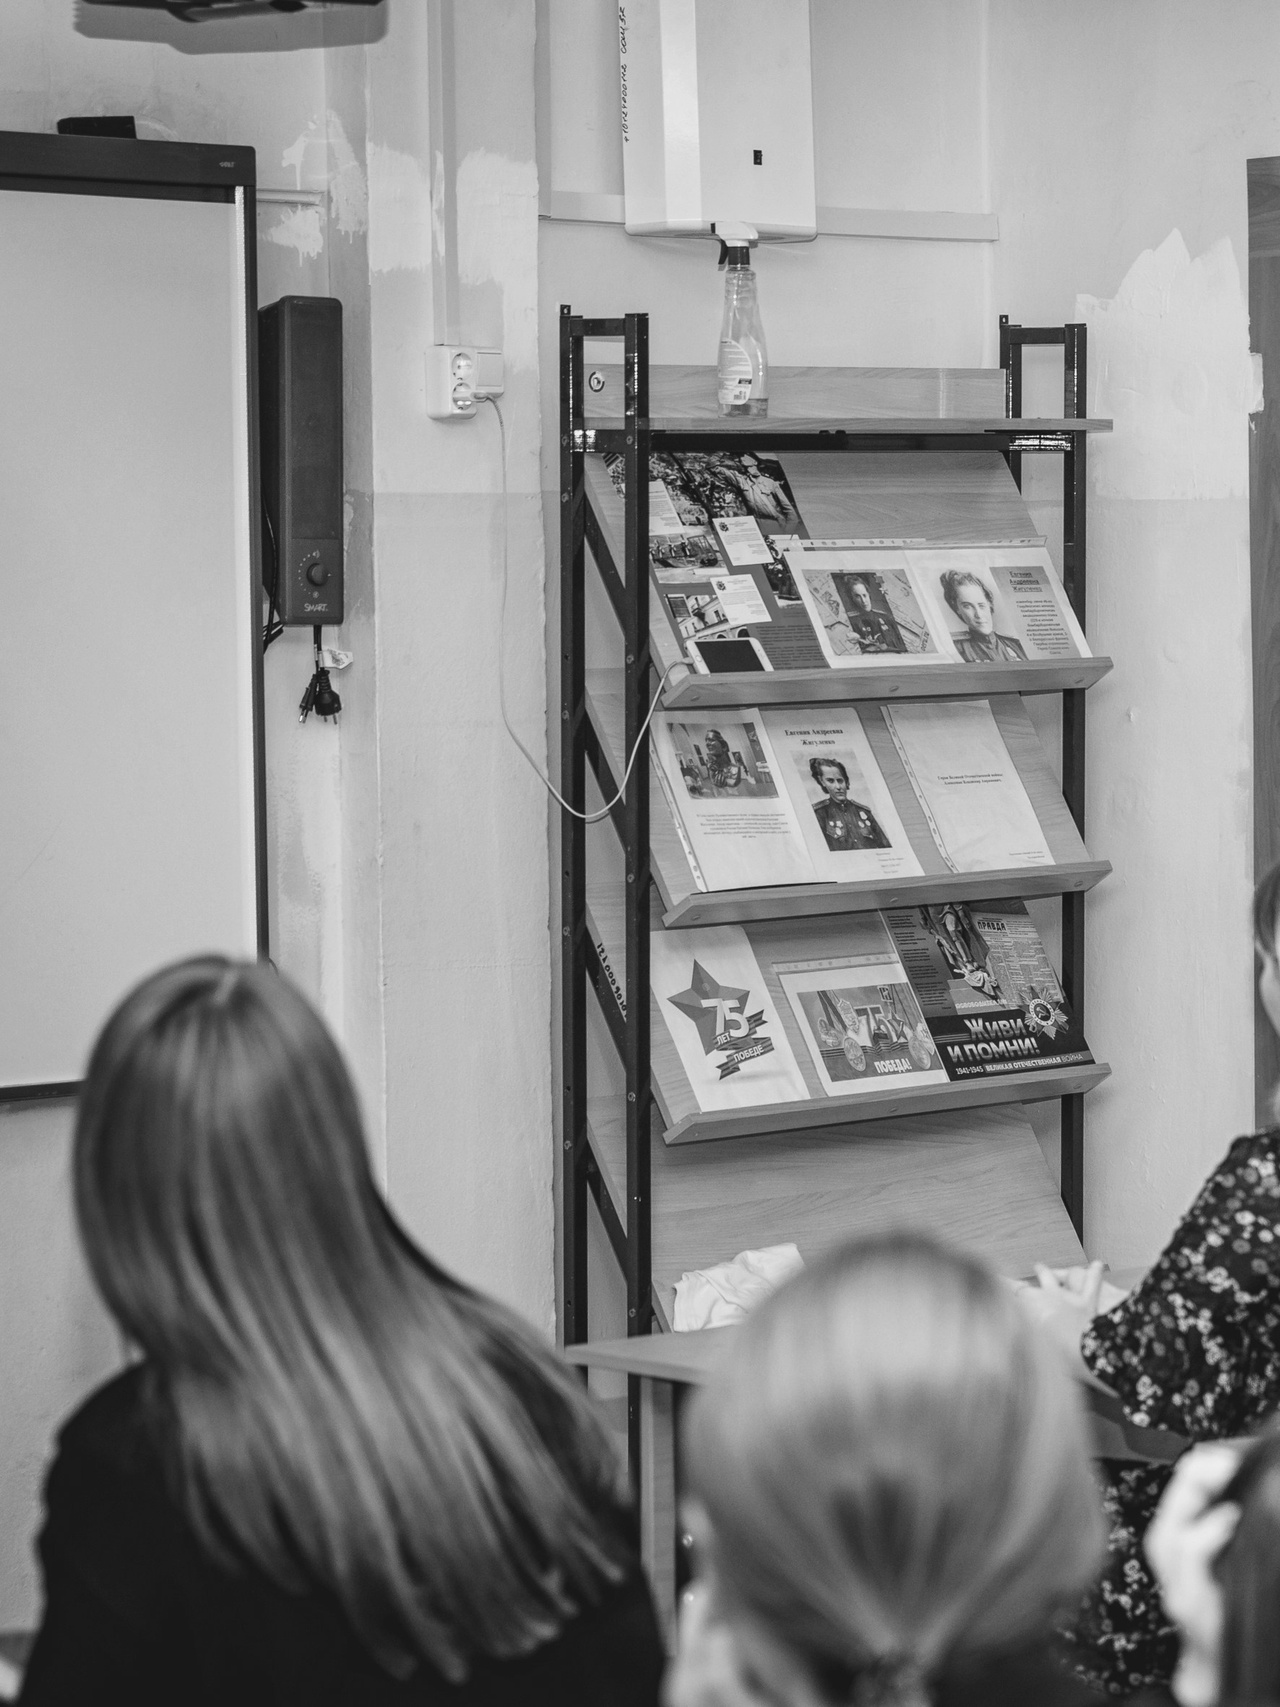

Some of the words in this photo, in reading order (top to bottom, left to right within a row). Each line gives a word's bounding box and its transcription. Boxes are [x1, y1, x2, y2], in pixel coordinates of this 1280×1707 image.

[977, 921, 1007, 932] ПРАВДА
[700, 997, 750, 1038] 75
[853, 1004, 897, 1047] 75
[717, 1031, 731, 1046] ЛЕТ
[733, 1044, 765, 1063] ПОБЕДЕ
[946, 1045, 965, 1063] И
[963, 1036, 1041, 1061] ПОМНИ!
[873, 1057, 913, 1074] ПОБЕДА!
[955, 1065, 984, 1075] 1941-1945
[985, 1062, 1014, 1072] ВЕЛИКАЯ
[1014, 1057, 1062, 1069] ОТЕЧЕСТВЕННАЯ
[1062, 1053, 1084, 1064] ВОЙНА
